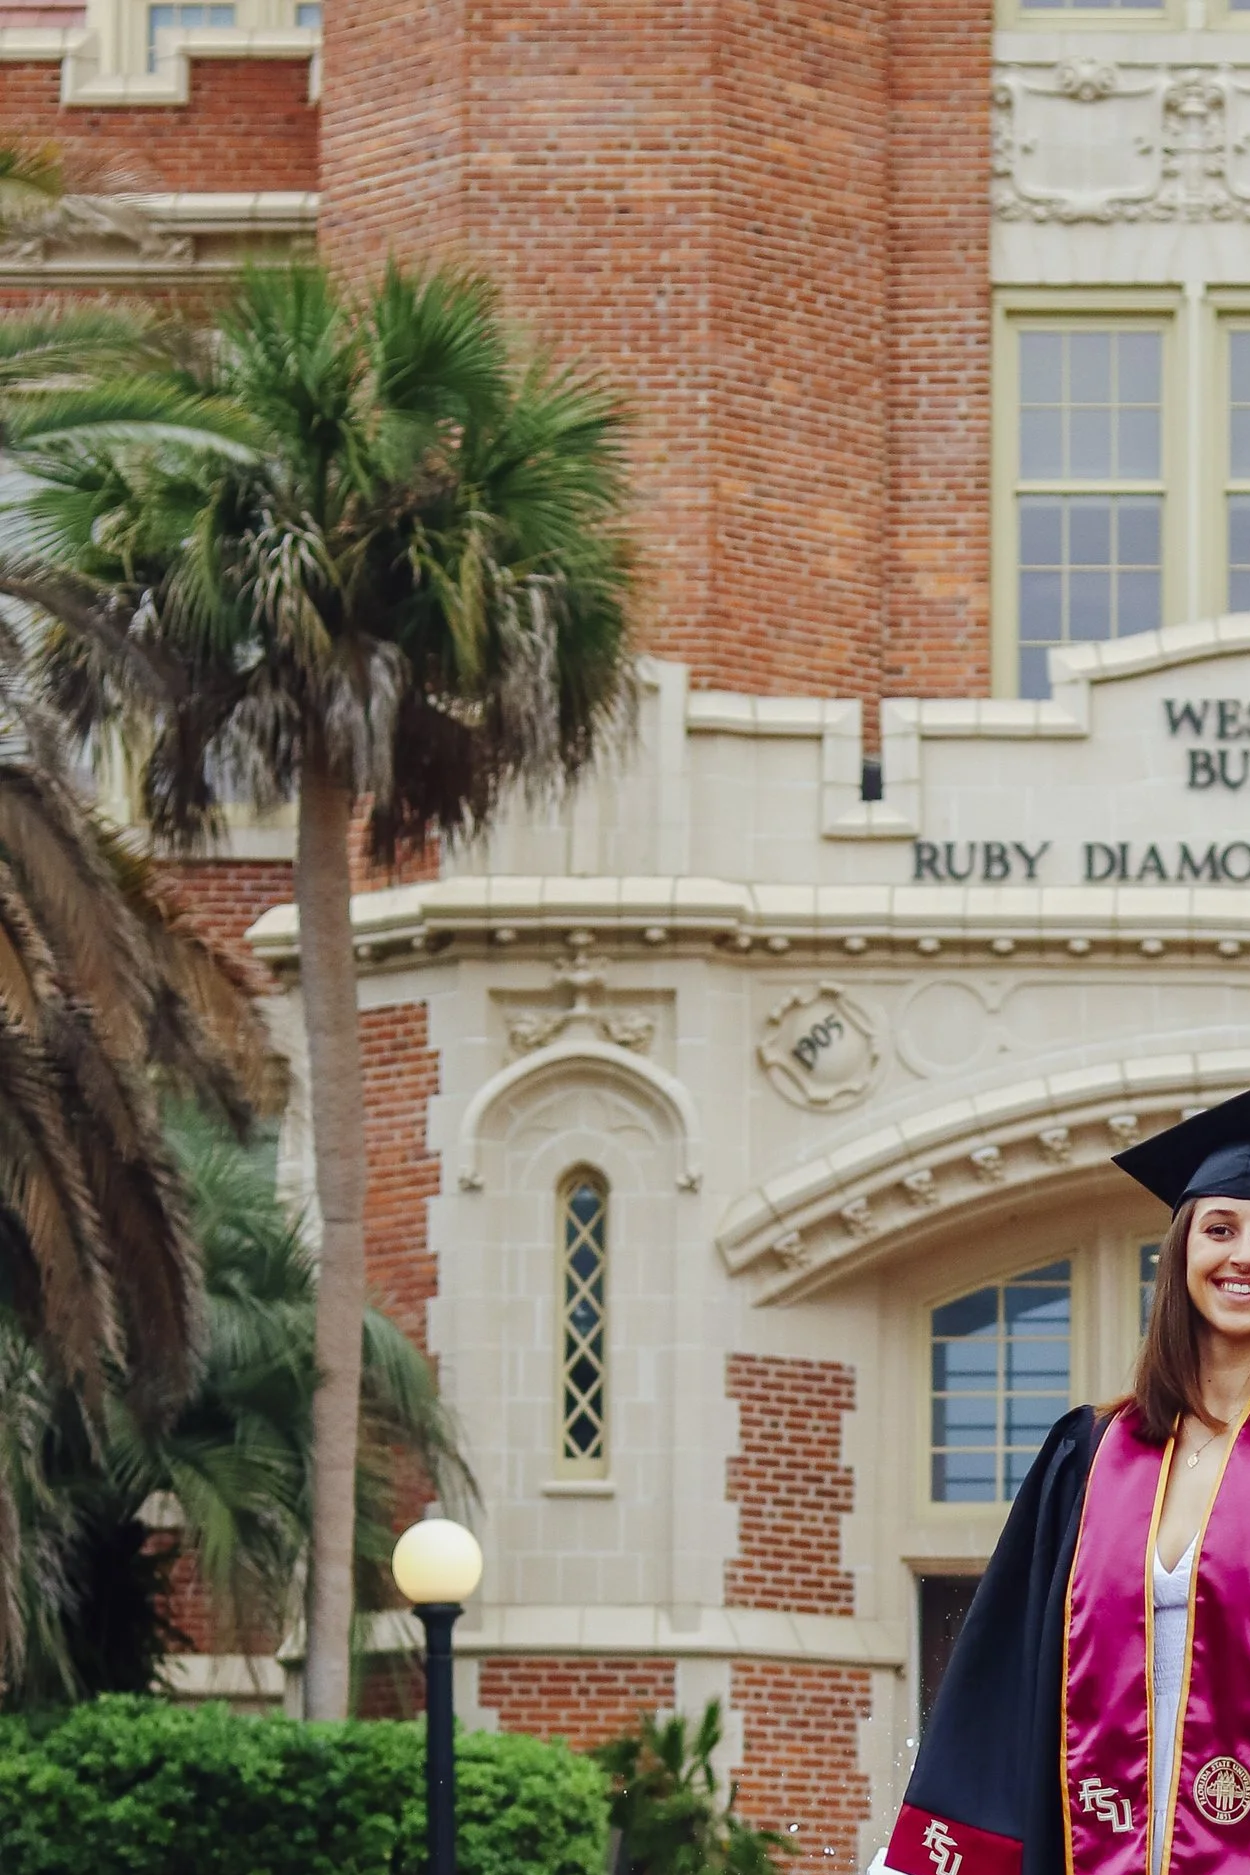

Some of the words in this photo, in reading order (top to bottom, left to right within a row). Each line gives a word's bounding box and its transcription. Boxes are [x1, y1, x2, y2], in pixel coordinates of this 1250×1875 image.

[912, 840, 1053, 883] RUBY
[1079, 1777, 1135, 1834] FSU
[1198, 1770, 1211, 1806] FLORIDA
[1211, 1760, 1231, 1772] STATE
[1233, 1763, 1250, 1808] UNIVERSITY
[1216, 1812, 1232, 1820] 1851
